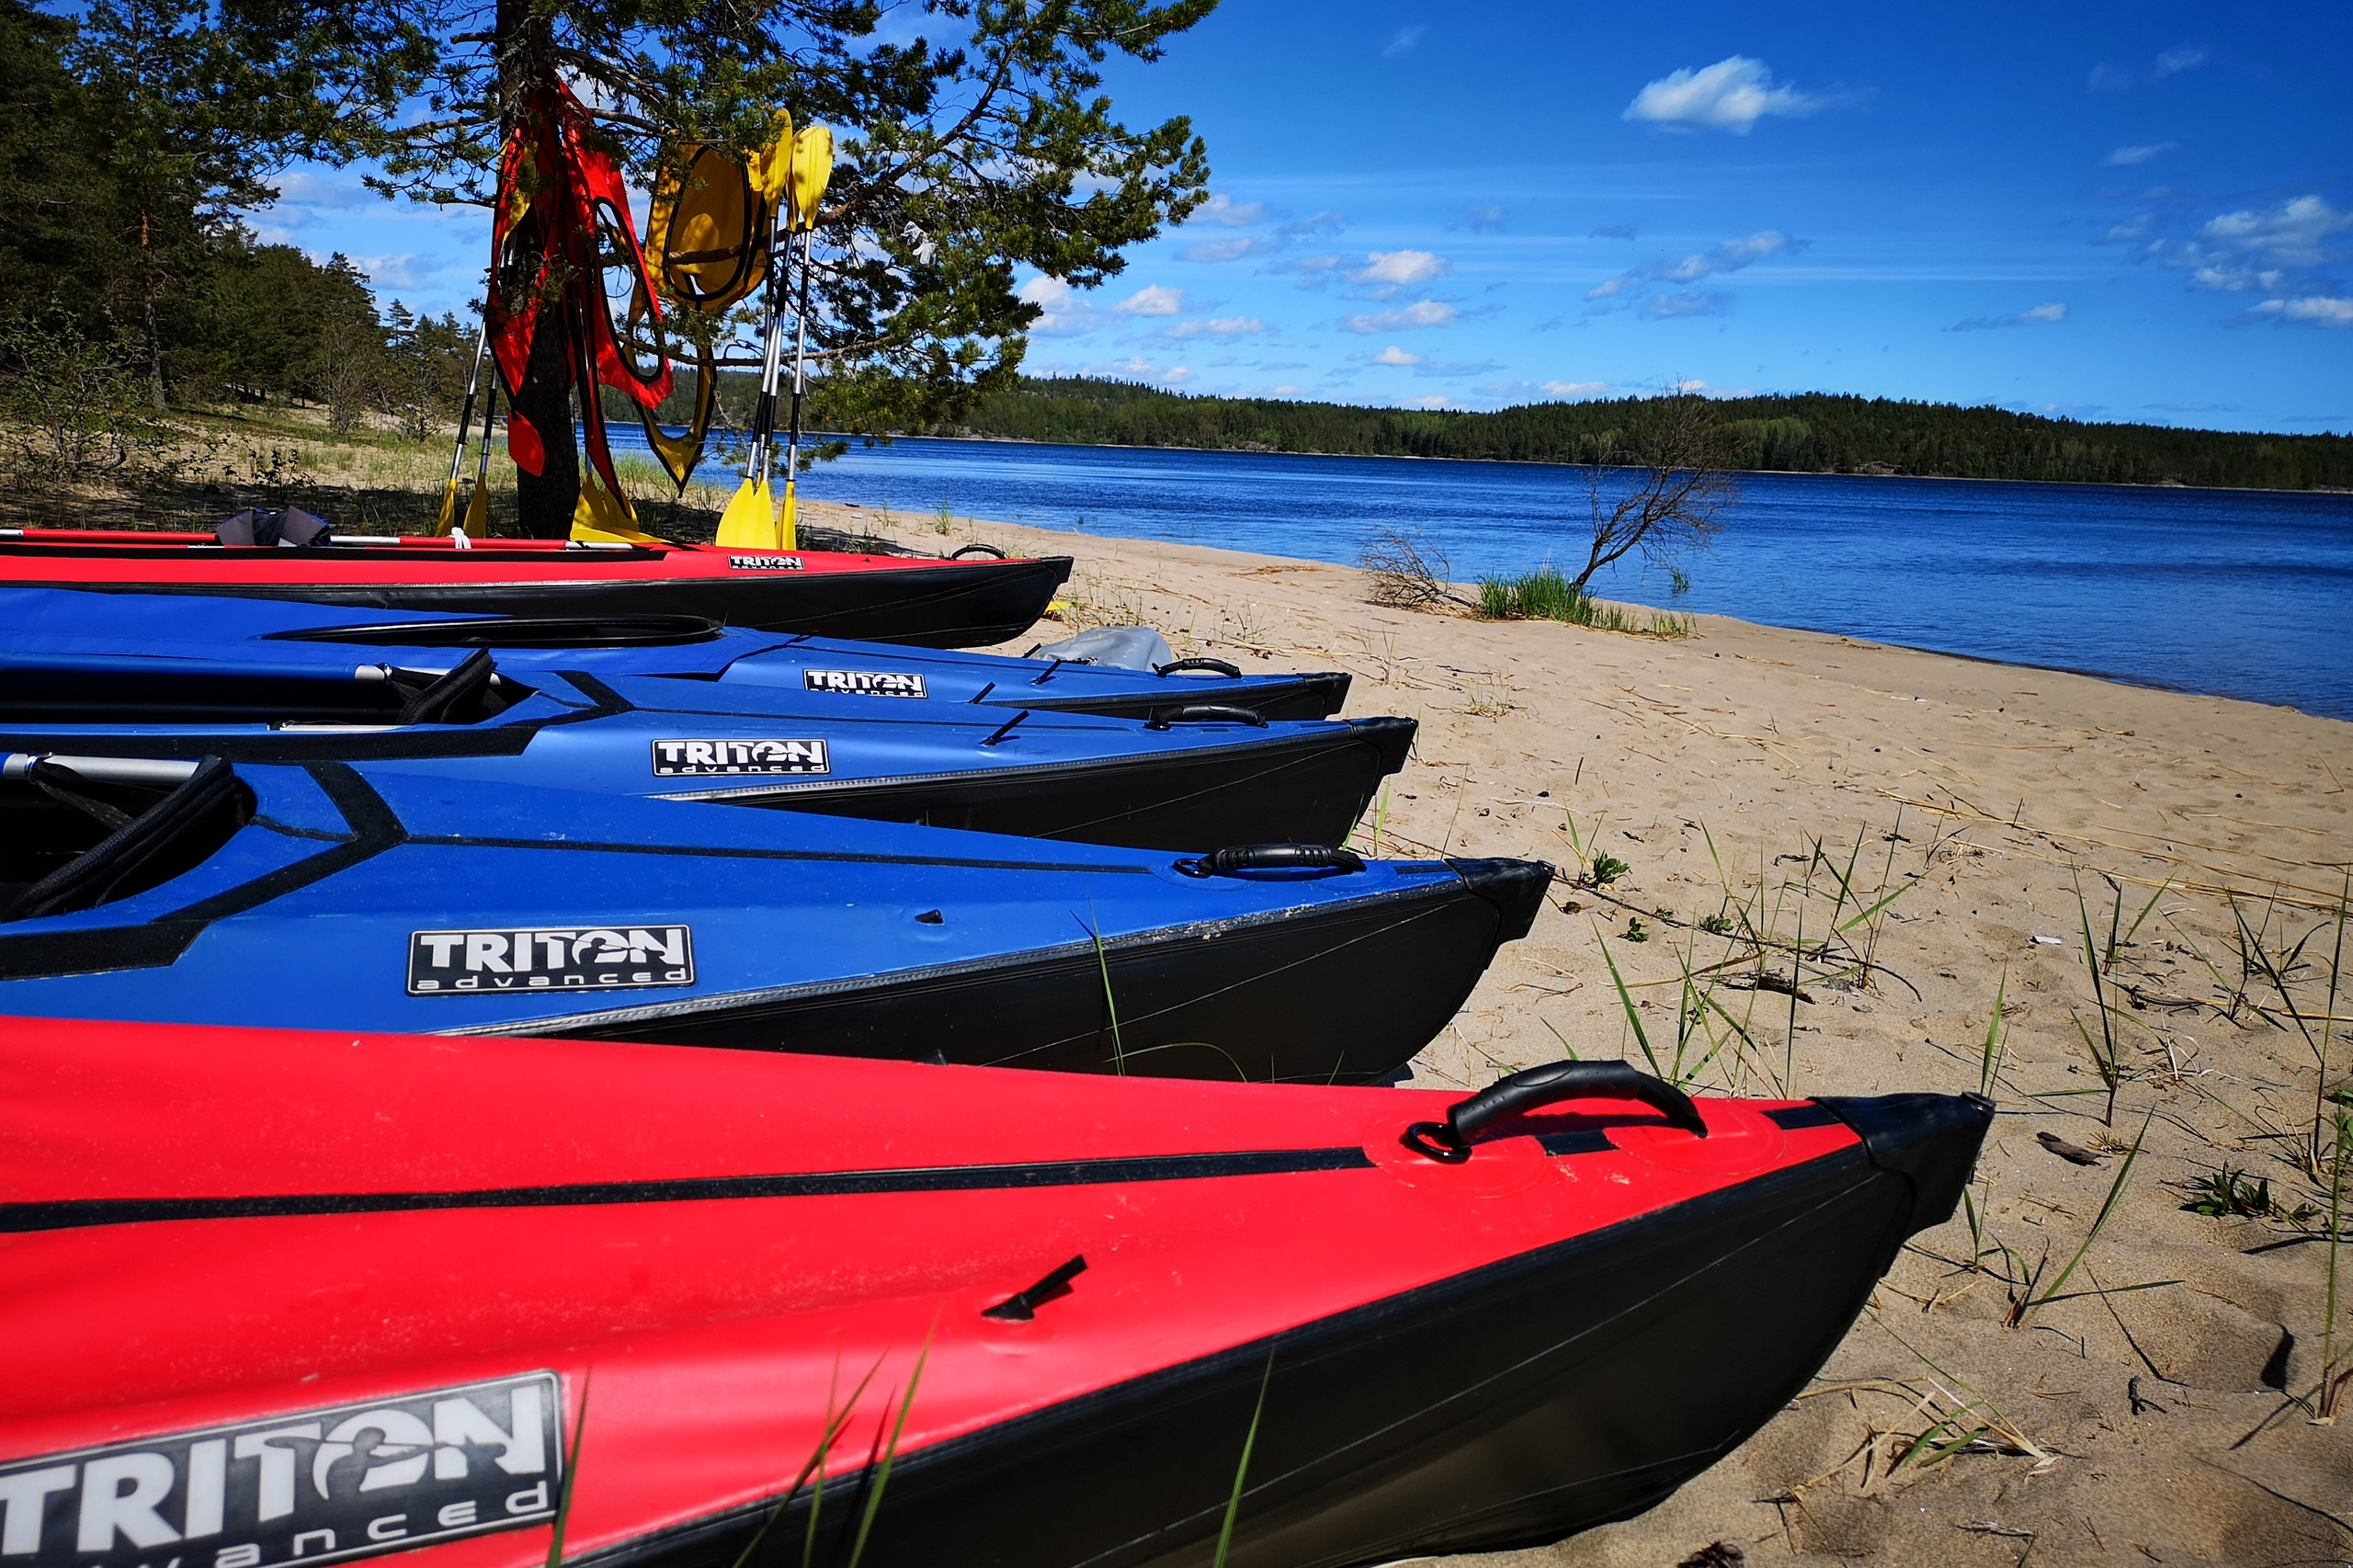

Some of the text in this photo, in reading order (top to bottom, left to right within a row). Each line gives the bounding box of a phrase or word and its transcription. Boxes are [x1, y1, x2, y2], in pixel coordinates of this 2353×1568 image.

[731, 556, 802, 566] TRITON
[807, 671, 922, 692] TRITON
[658, 741, 824, 765] TRITON
[659, 765, 824, 774] advanced
[420, 928, 685, 972] TRITON
[417, 968, 686, 990] advanced
[0, 1385, 545, 1556] TRITON
